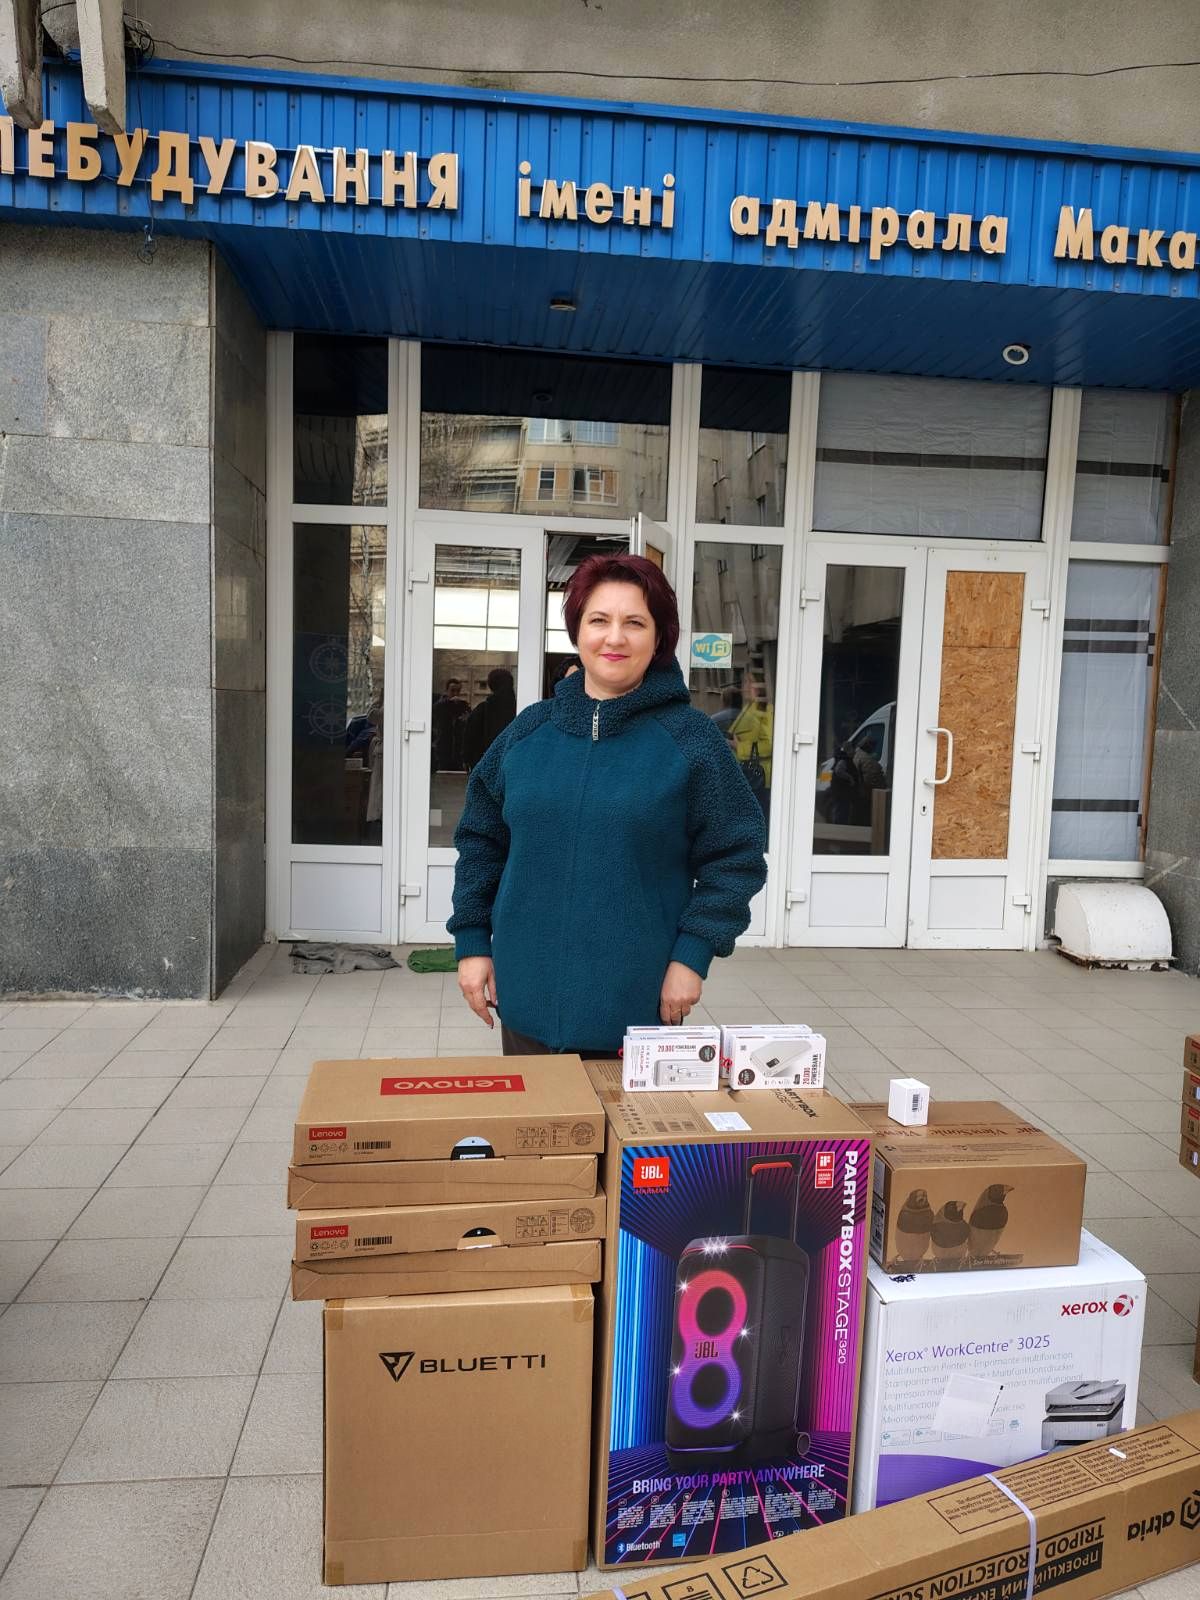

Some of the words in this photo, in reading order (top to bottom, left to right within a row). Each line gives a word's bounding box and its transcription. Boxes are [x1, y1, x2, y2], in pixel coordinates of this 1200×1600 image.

[518, 160, 676, 228] імені
[729, 195, 1009, 261] адмірала
[1053, 205, 1197, 270] Мака
[393, 1078, 513, 1091] Lenovo
[312, 1130, 344, 1138] Lenovo
[641, 1165, 664, 1180] JBL
[313, 1228, 346, 1238] Lenovo
[1061, 1301, 1108, 1317] xerox
[695, 1341, 718, 1359] JBL
[1017, 1335, 1050, 1350] 3025
[419, 1354, 546, 1374] BLUETTI
[632, 1477, 671, 1494] BRING
[676, 1474, 709, 1490] YOUR
[713, 1471, 751, 1487] PARTY
[757, 1464, 826, 1483] ANYWHERE
[1127, 1510, 1175, 1541] atria
[626, 1541, 661, 1551] Bluetooth
[1044, 1523, 1104, 1558] TRIPOD
